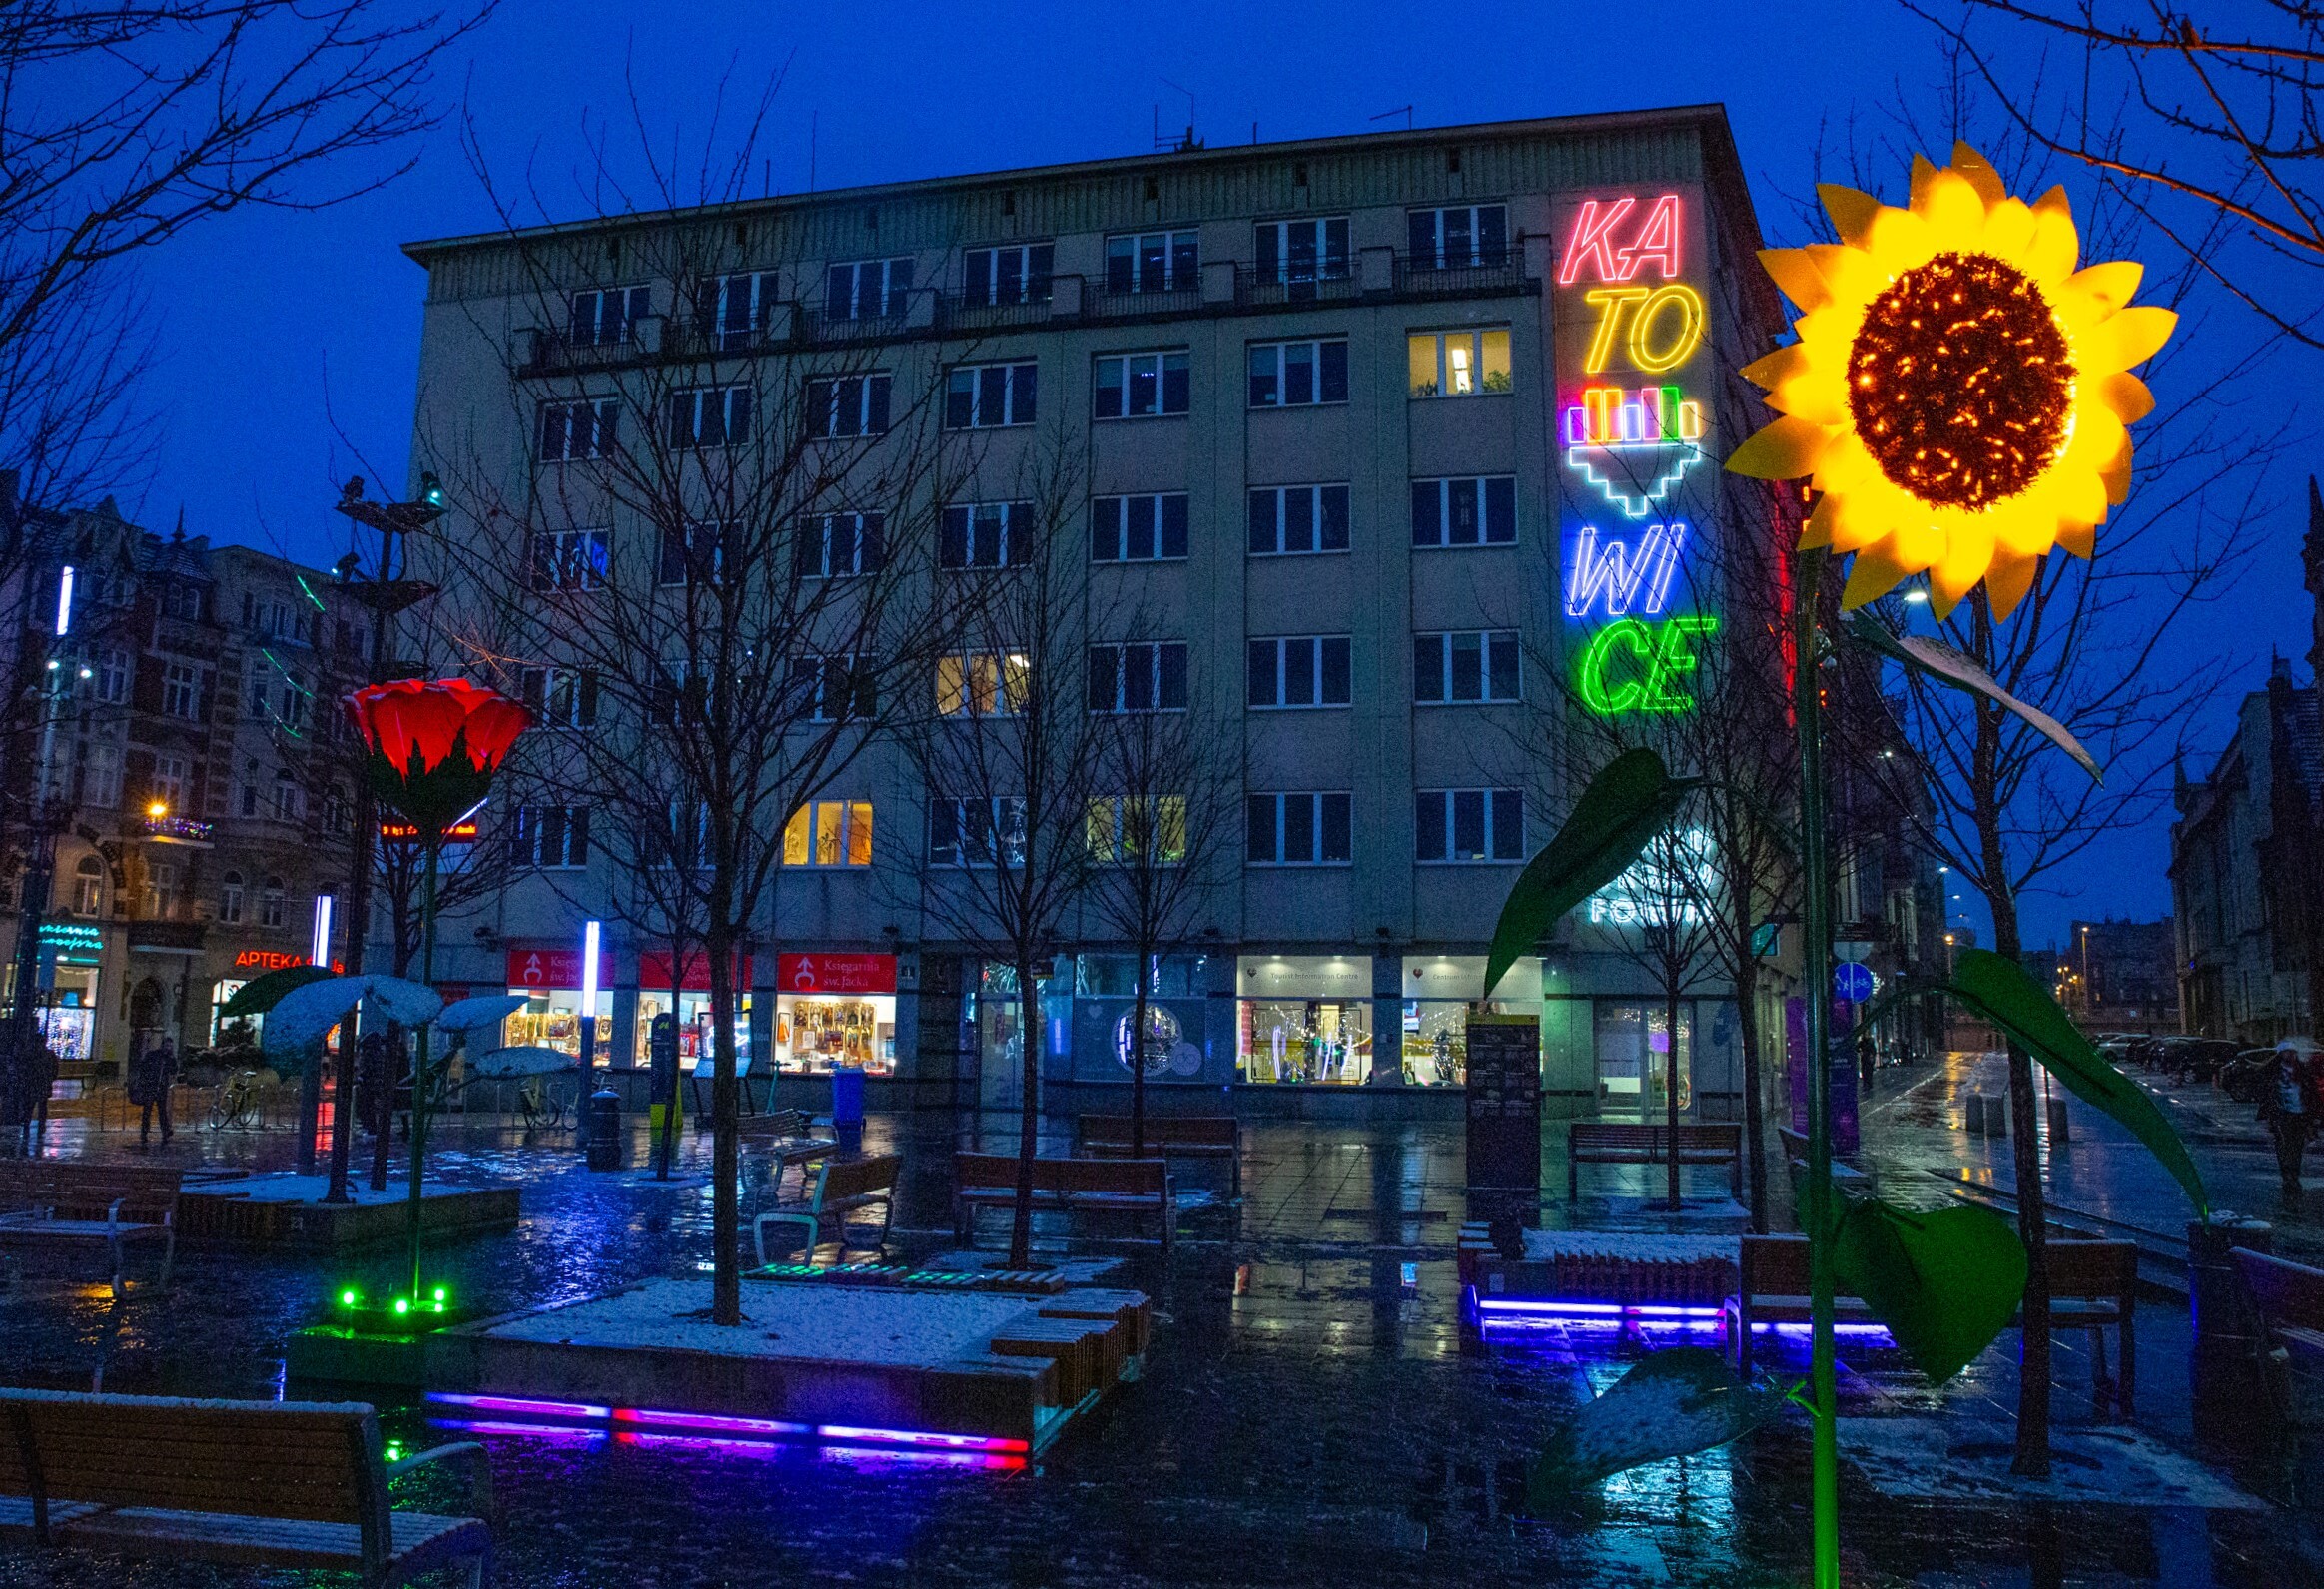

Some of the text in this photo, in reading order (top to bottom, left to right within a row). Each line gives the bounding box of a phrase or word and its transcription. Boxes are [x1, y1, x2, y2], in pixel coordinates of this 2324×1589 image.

[1559, 194, 1680, 284] KA
[1585, 284, 1703, 374] TO
[1568, 523, 1684, 616] WI
[1583, 617, 1718, 713] CE
[235, 951, 303, 970] APTEKA
[823, 959, 880, 974] Księgarnia
